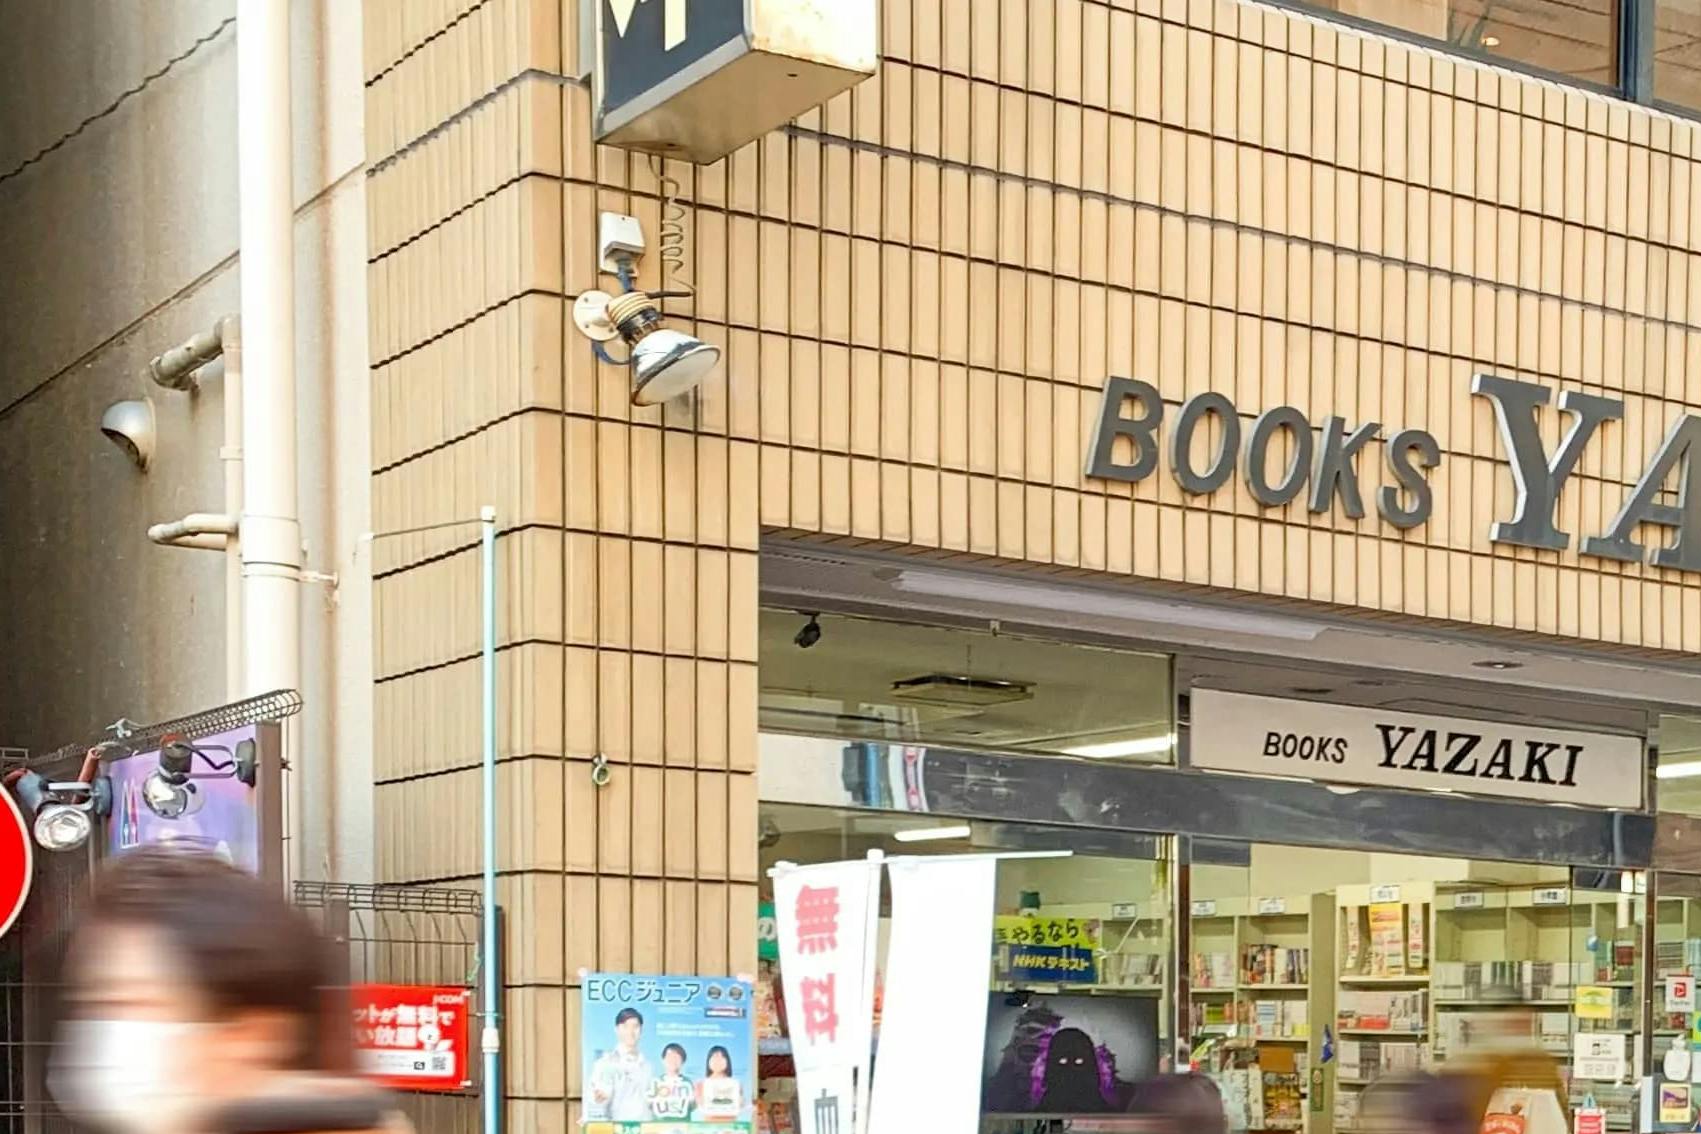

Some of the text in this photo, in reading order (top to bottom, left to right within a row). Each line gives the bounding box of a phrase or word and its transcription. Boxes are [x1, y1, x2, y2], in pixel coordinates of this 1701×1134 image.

[1086, 375, 1441, 530] BOOKS
[1262, 723, 1584, 787] BOOKS YAZAKI
